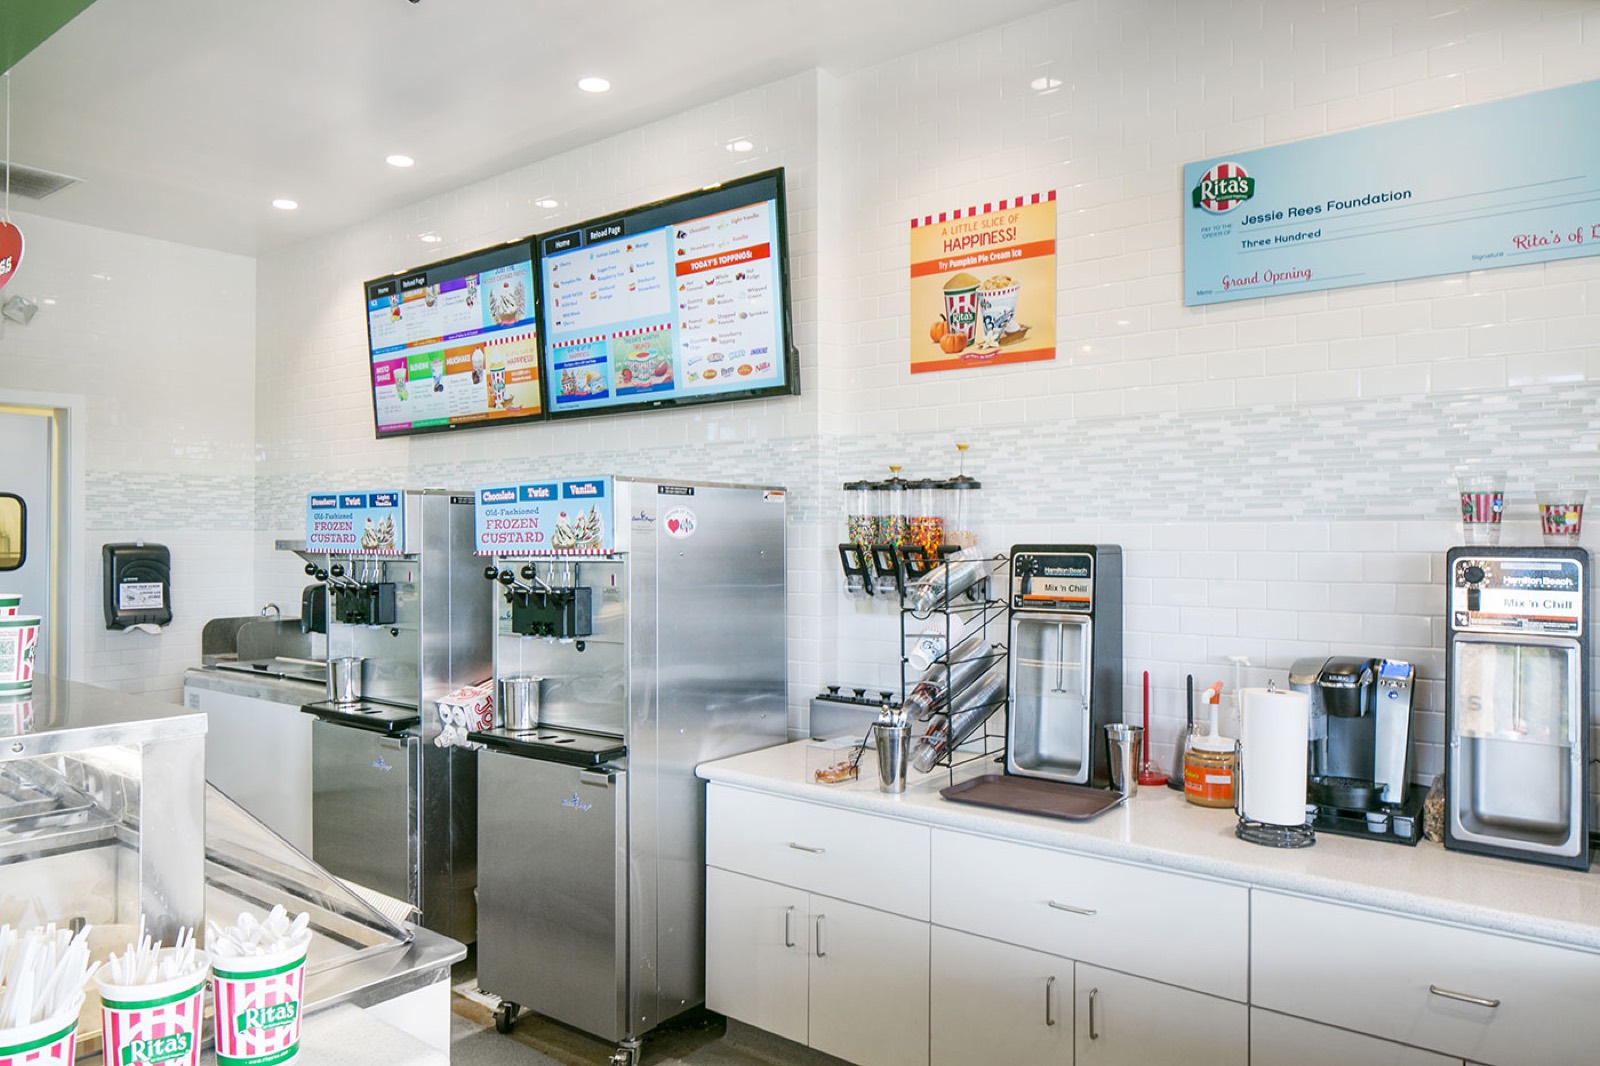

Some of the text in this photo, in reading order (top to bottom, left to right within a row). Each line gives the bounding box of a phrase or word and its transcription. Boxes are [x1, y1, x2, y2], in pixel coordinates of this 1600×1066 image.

[1201, 177, 1249, 201] Rita's
[1242, 189, 1412, 226] Jessie Rees Foundation
[941, 213, 1020, 236] A LITTLE SLICE OF
[1201, 225, 1212, 233] PAY
[555, 226, 621, 249] Home Reload Page
[943, 226, 1017, 253] HAPPINESS!
[1202, 231, 1223, 239] ORDER
[1241, 229, 1322, 249] Three Hundred
[1512, 230, 1561, 250] Rita's
[1568, 226, 1583, 244] of
[690, 250, 752, 270] TODAY'S TOPPINGS:
[938, 248, 1022, 270] Try Pumpkin Pie Cream Ice
[1472, 251, 1504, 261] Signature
[1222, 266, 1313, 291] Grand Opening
[952, 311, 974, 323] Rita's
[527, 487, 550, 498] Twist
[569, 483, 598, 495] Vanilla
[482, 491, 515, 502] Chocolate
[314, 512, 353, 520] Old-Fashioned
[485, 507, 540, 517] Old-Fashioned
[314, 521, 353, 531] FROZEN
[486, 518, 539, 530] FROZEN
[310, 533, 357, 544] CUSTARD
[481, 531, 545, 544] CUSTARD
[1503, 575, 1542, 585] Hamilton
[1045, 584, 1058, 592] Mix
[1504, 599, 1572, 609] Mix 'n Chill
[246, 1002, 294, 1029] Rita's
[130, 1033, 187, 1063] Rita's
